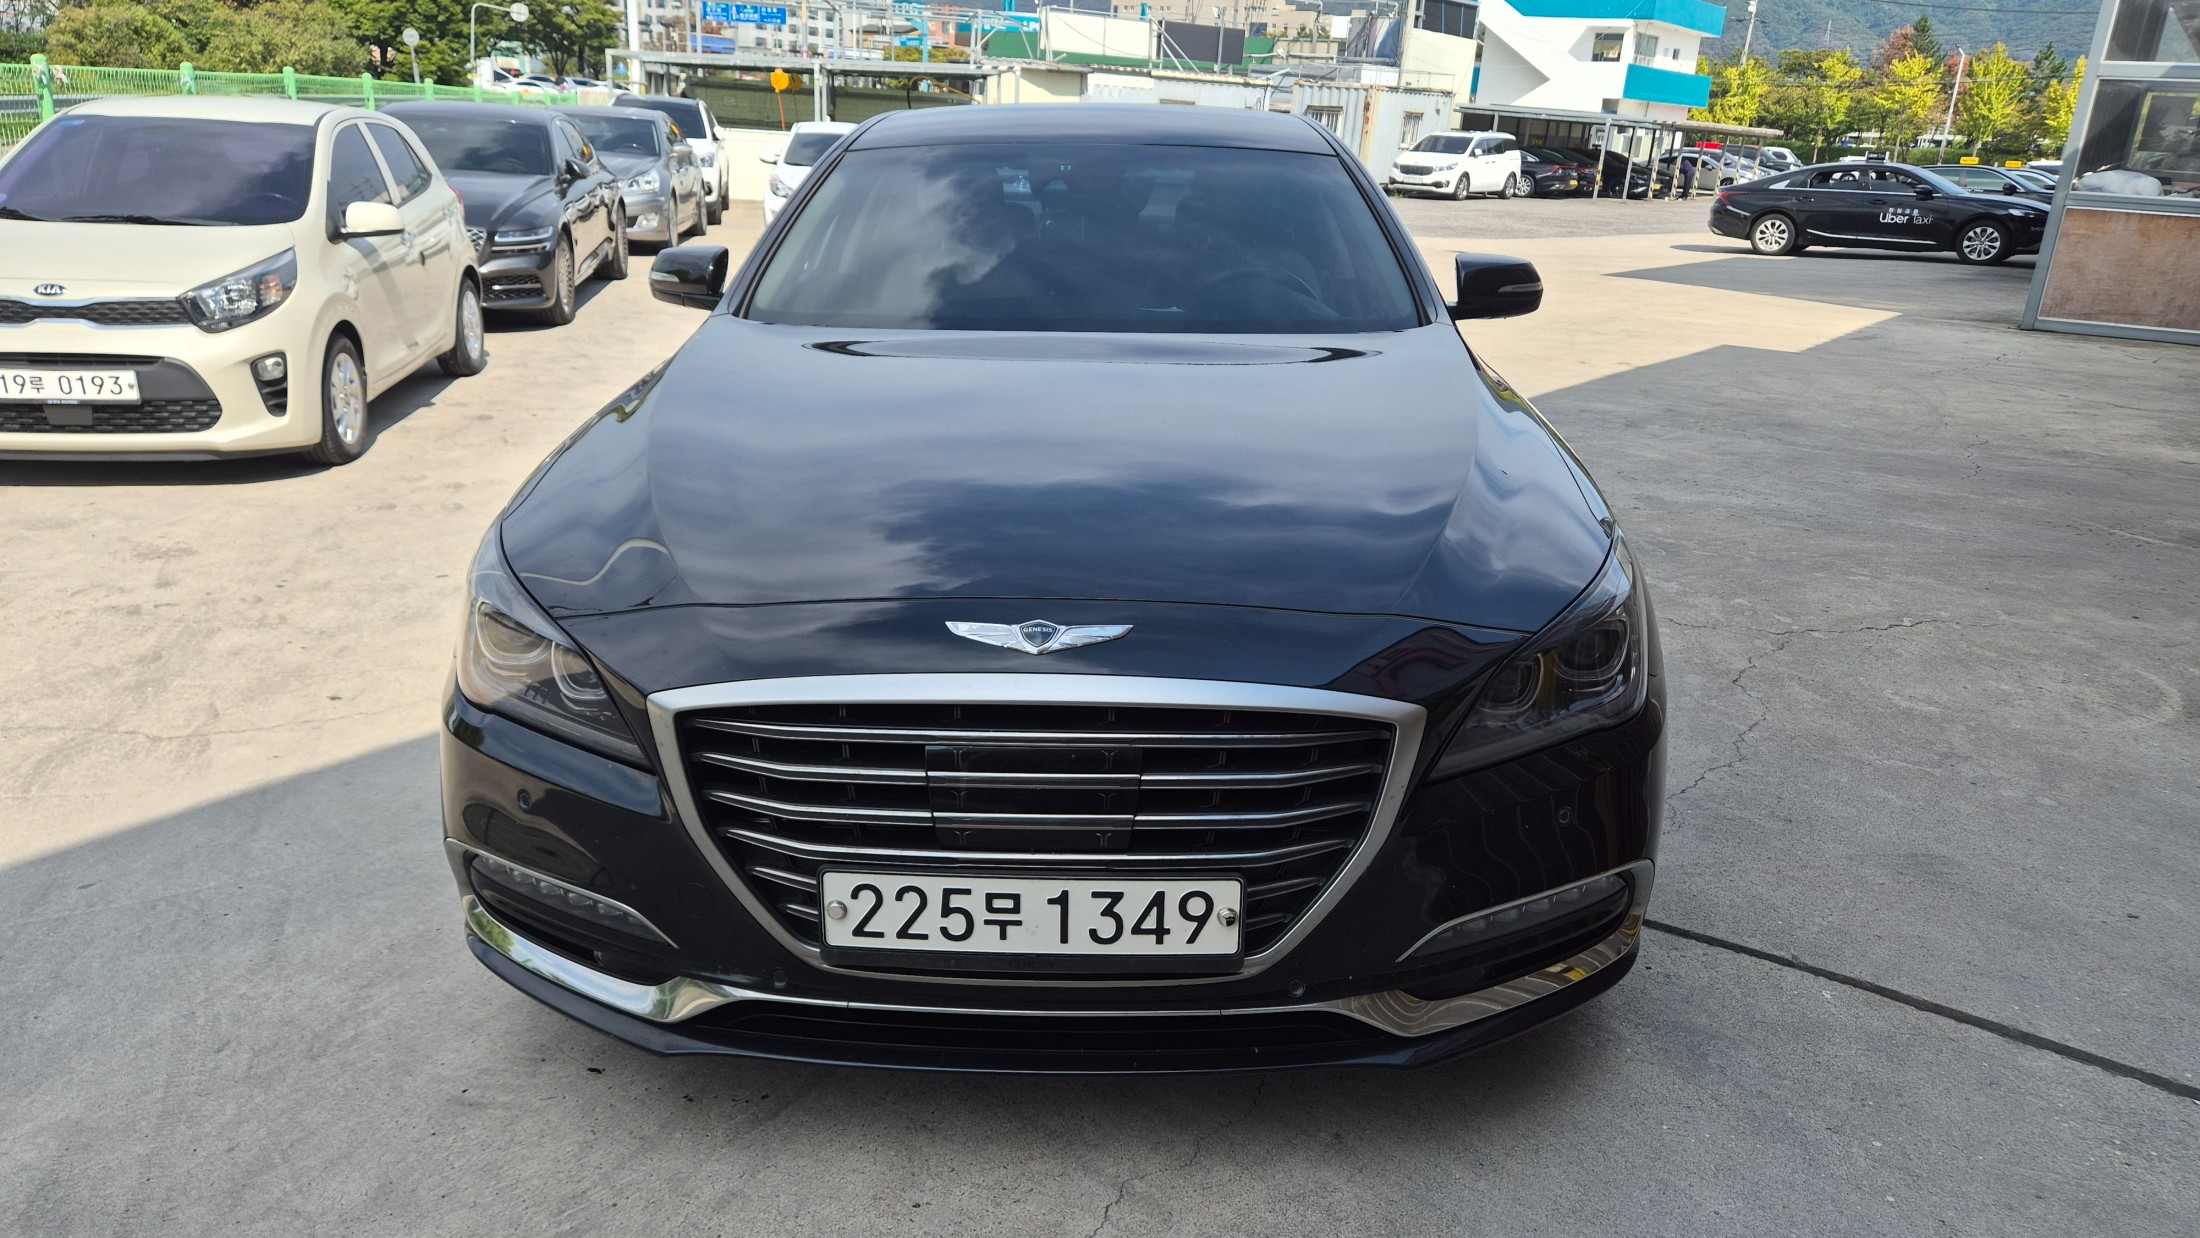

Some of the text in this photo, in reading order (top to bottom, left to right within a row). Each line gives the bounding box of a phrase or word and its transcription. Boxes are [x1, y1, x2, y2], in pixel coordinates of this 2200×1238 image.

[1880, 212, 1932, 225] Uber Taxi
[38, 284, 62, 294] KIA
[58, 375, 123, 395] 0193
[850, 883, 1215, 945] 225무 1349
